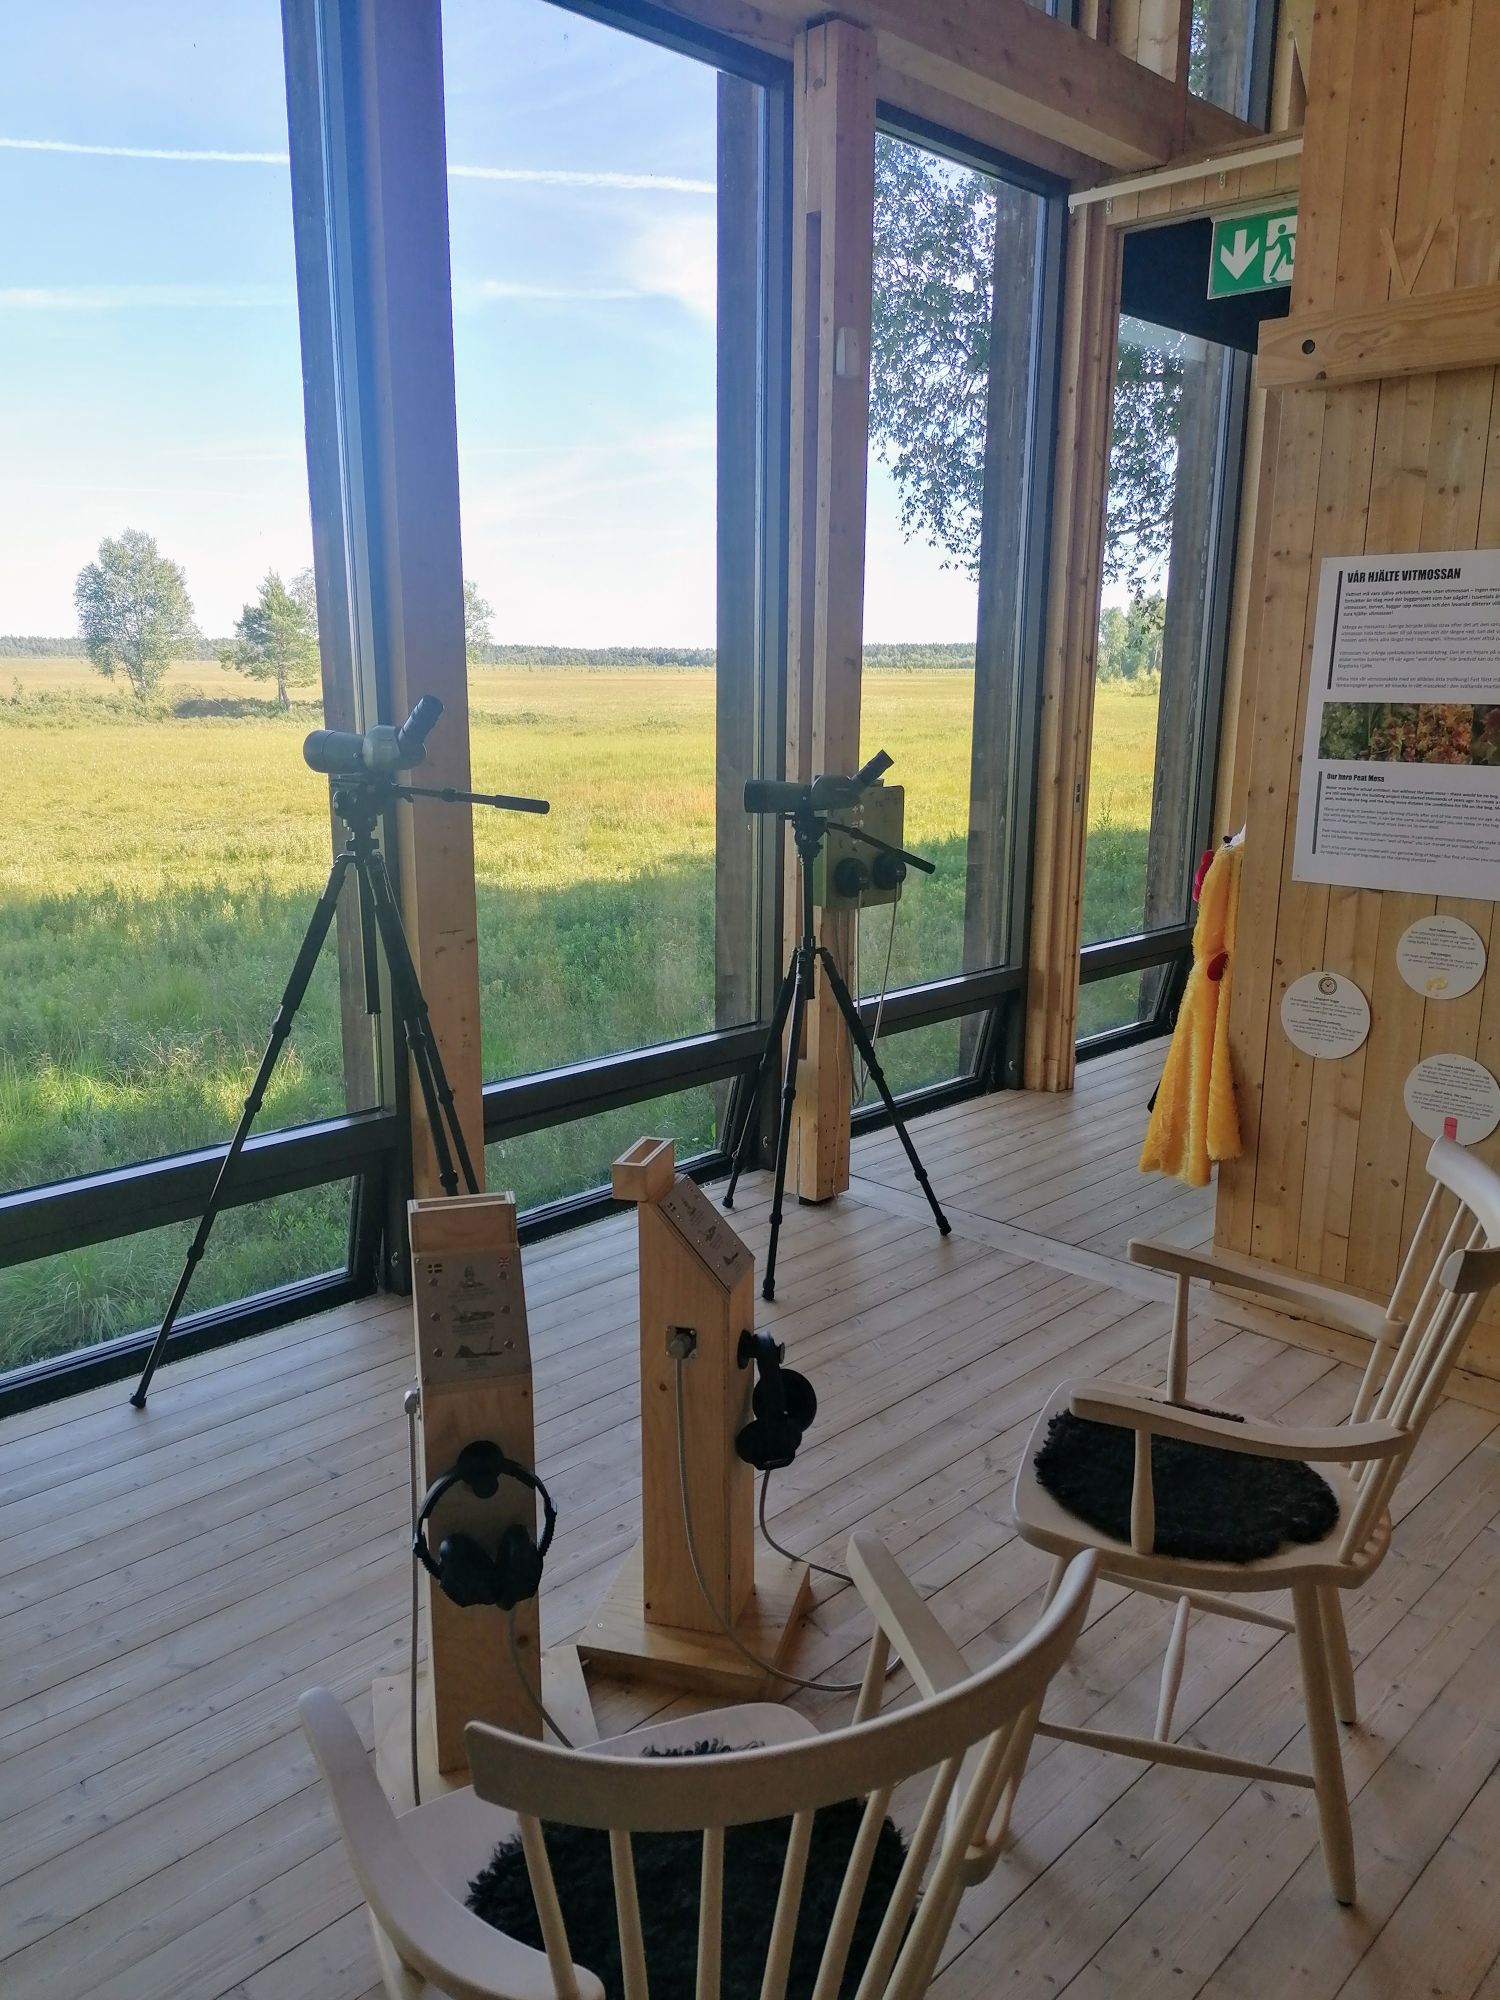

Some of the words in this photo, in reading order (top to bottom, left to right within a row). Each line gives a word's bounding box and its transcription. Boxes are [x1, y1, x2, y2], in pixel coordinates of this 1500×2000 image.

[1347, 570, 1366, 583] VÅR
[1367, 569, 1400, 582] HJÄLTE
[1402, 568, 1462, 581] VITMOSSAN
[1326, 772, 1338, 780] Our
[1353, 774, 1367, 782] Peat
[1367, 775, 1385, 783] Moss
